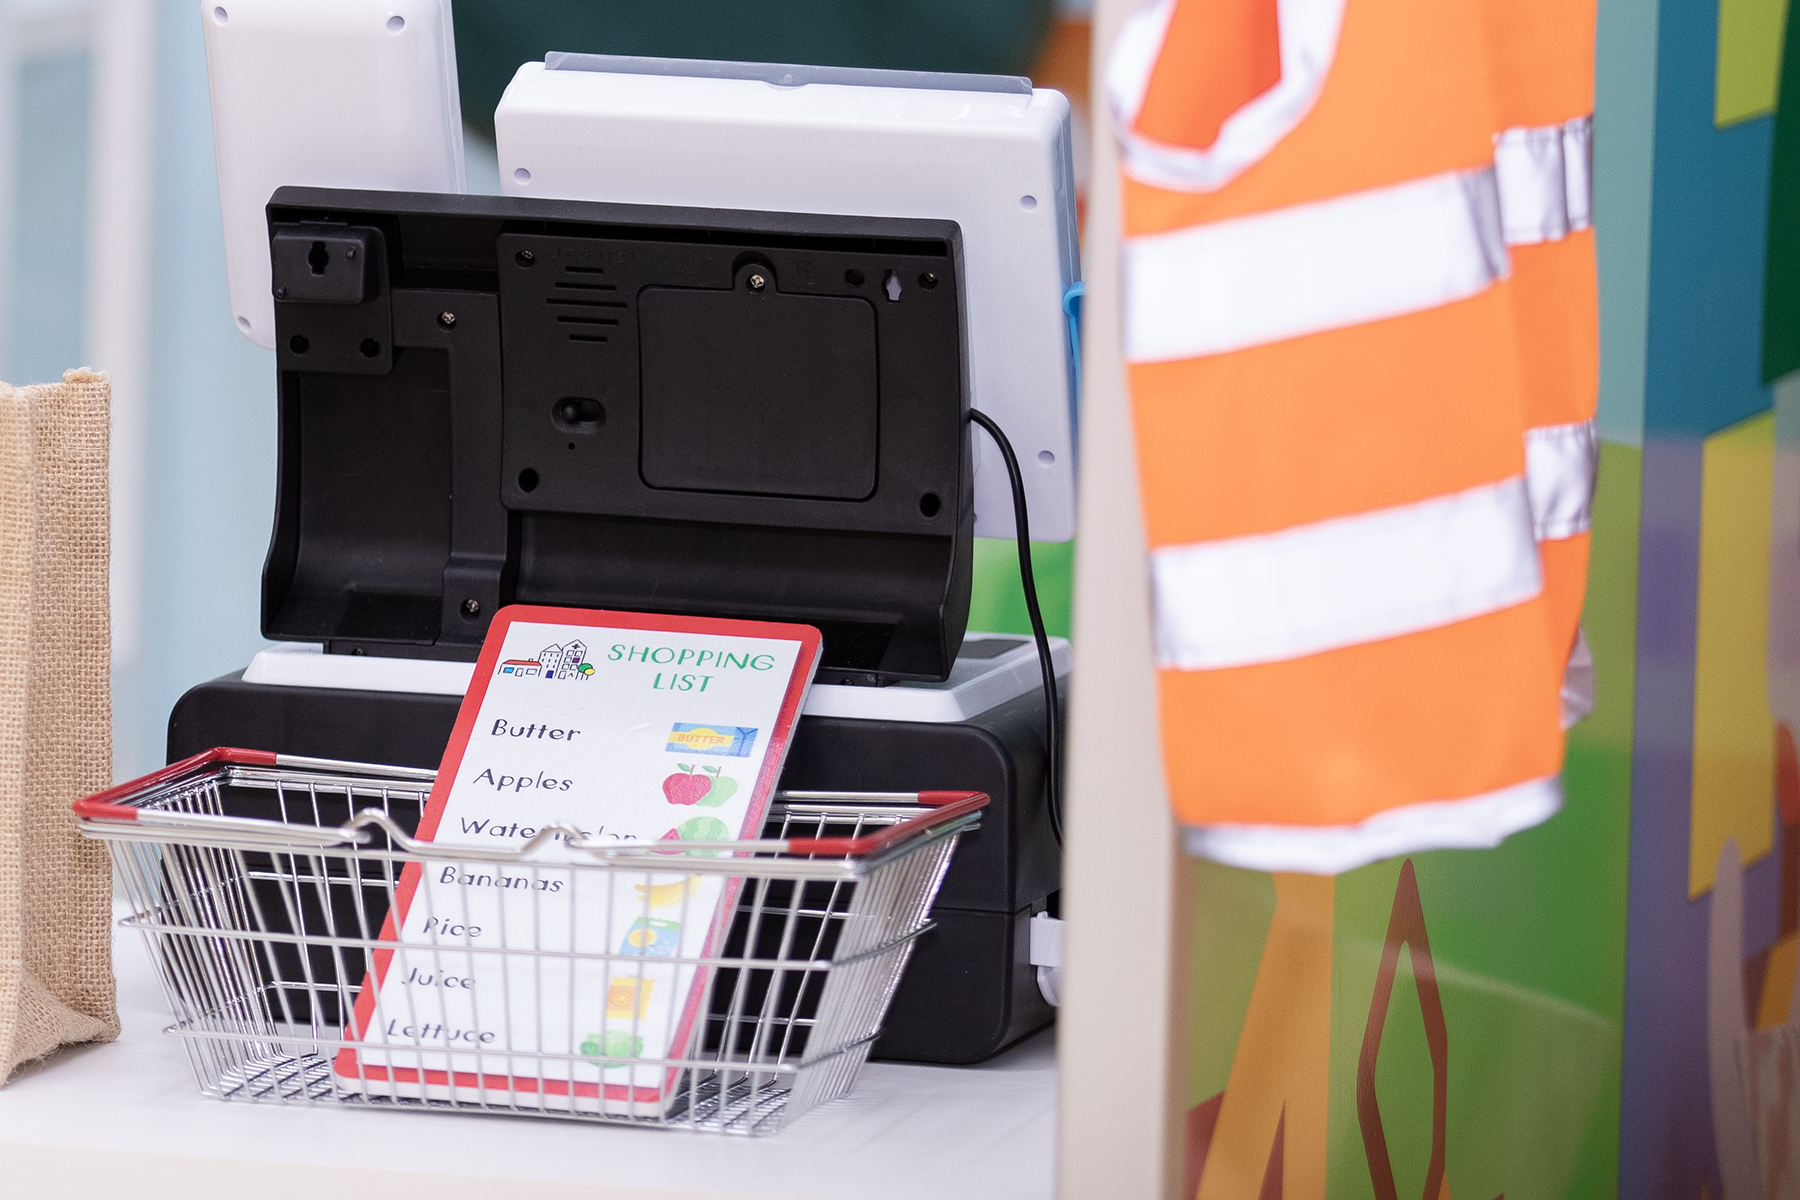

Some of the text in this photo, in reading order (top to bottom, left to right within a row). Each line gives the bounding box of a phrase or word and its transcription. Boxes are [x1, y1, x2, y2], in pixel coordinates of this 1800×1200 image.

[606, 643, 777, 672] SHOPPING
[652, 672, 715, 693] LIST
[490, 718, 582, 742] Butter
[677, 732, 725, 745] BUTTER
[473, 767, 574, 792] Apples
[460, 815, 638, 842] Watemel
[439, 866, 565, 894] Bananas
[421, 917, 483, 938] Rice
[401, 967, 477, 990] Juice
[386, 1018, 497, 1044] Lettuce
